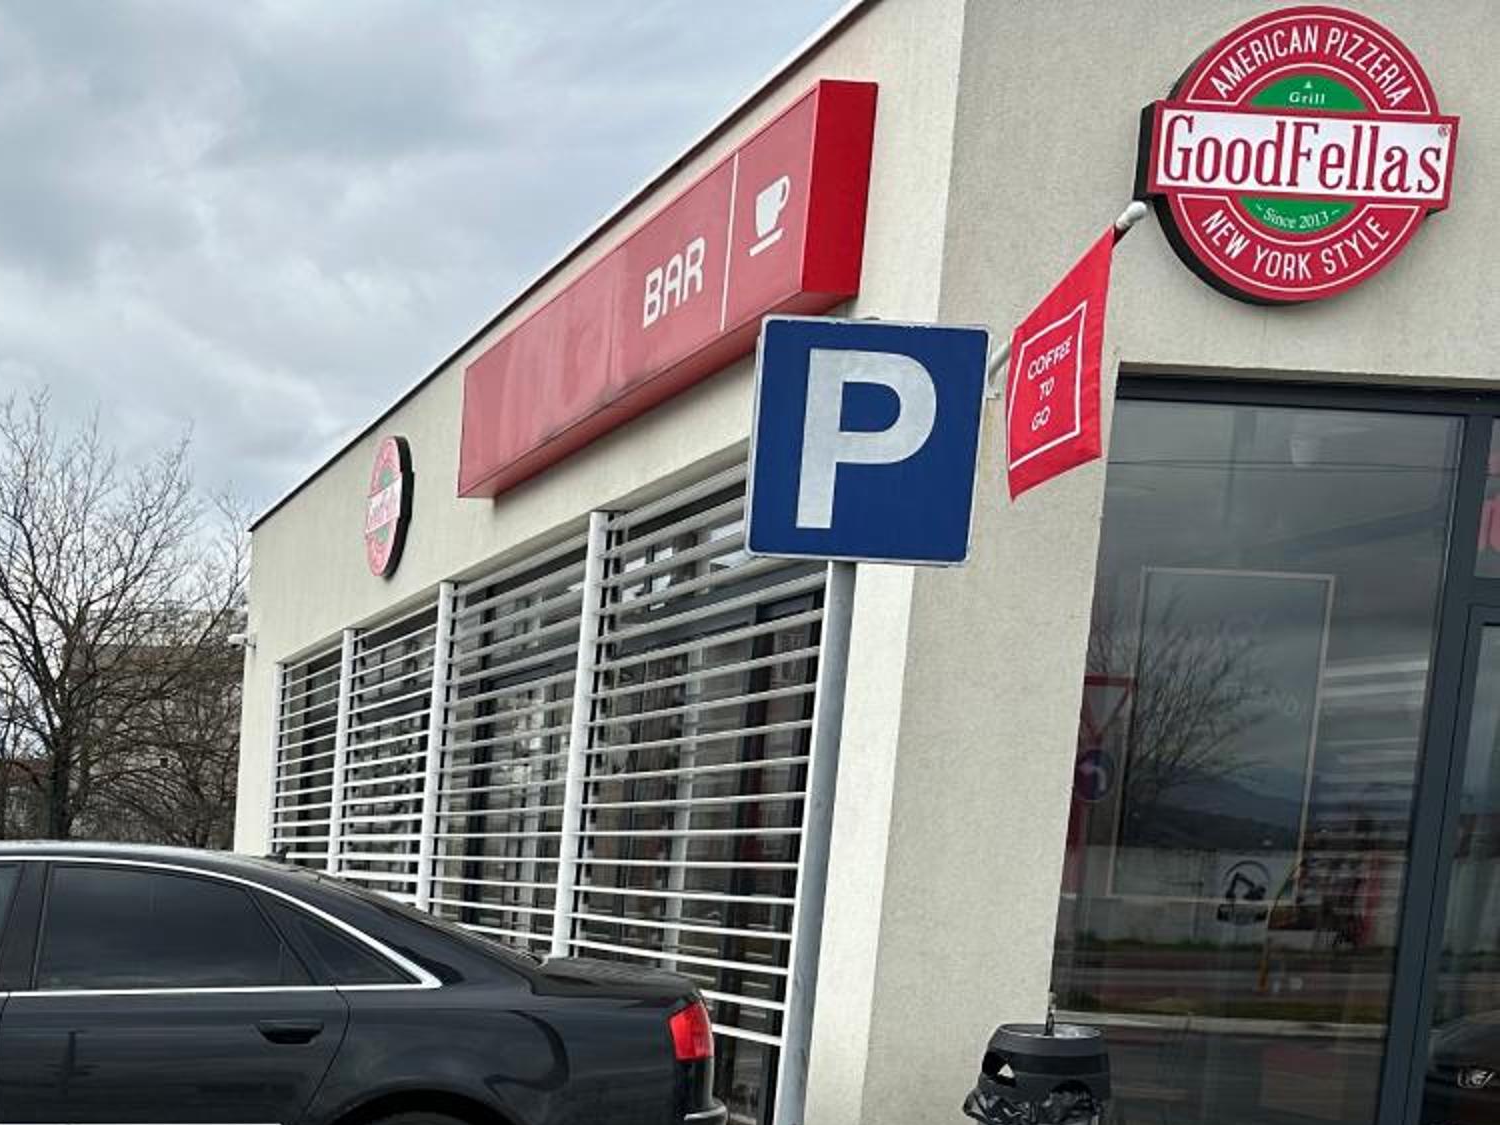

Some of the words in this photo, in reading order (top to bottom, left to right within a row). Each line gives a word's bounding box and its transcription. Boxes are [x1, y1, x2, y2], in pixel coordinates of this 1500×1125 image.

[1210, 25, 1319, 99] AMERICAN
[1324, 27, 1413, 108] PIZZERIA
[1288, 91, 1326, 105] Grill
[1162, 114, 1442, 194] GoodFellas
[1202, 209, 1250, 260] NEW
[1252, 244, 1313, 281] YORK
[1321, 216, 1390, 275] STYLE
[1263, 207, 1297, 229] Since
[642, 236, 705, 329] BAR
[1027, 335, 1073, 380] COFFEE
[1039, 376, 1055, 401] TO
[795, 347, 938, 529] P
[1031, 405, 1051, 431] GO
